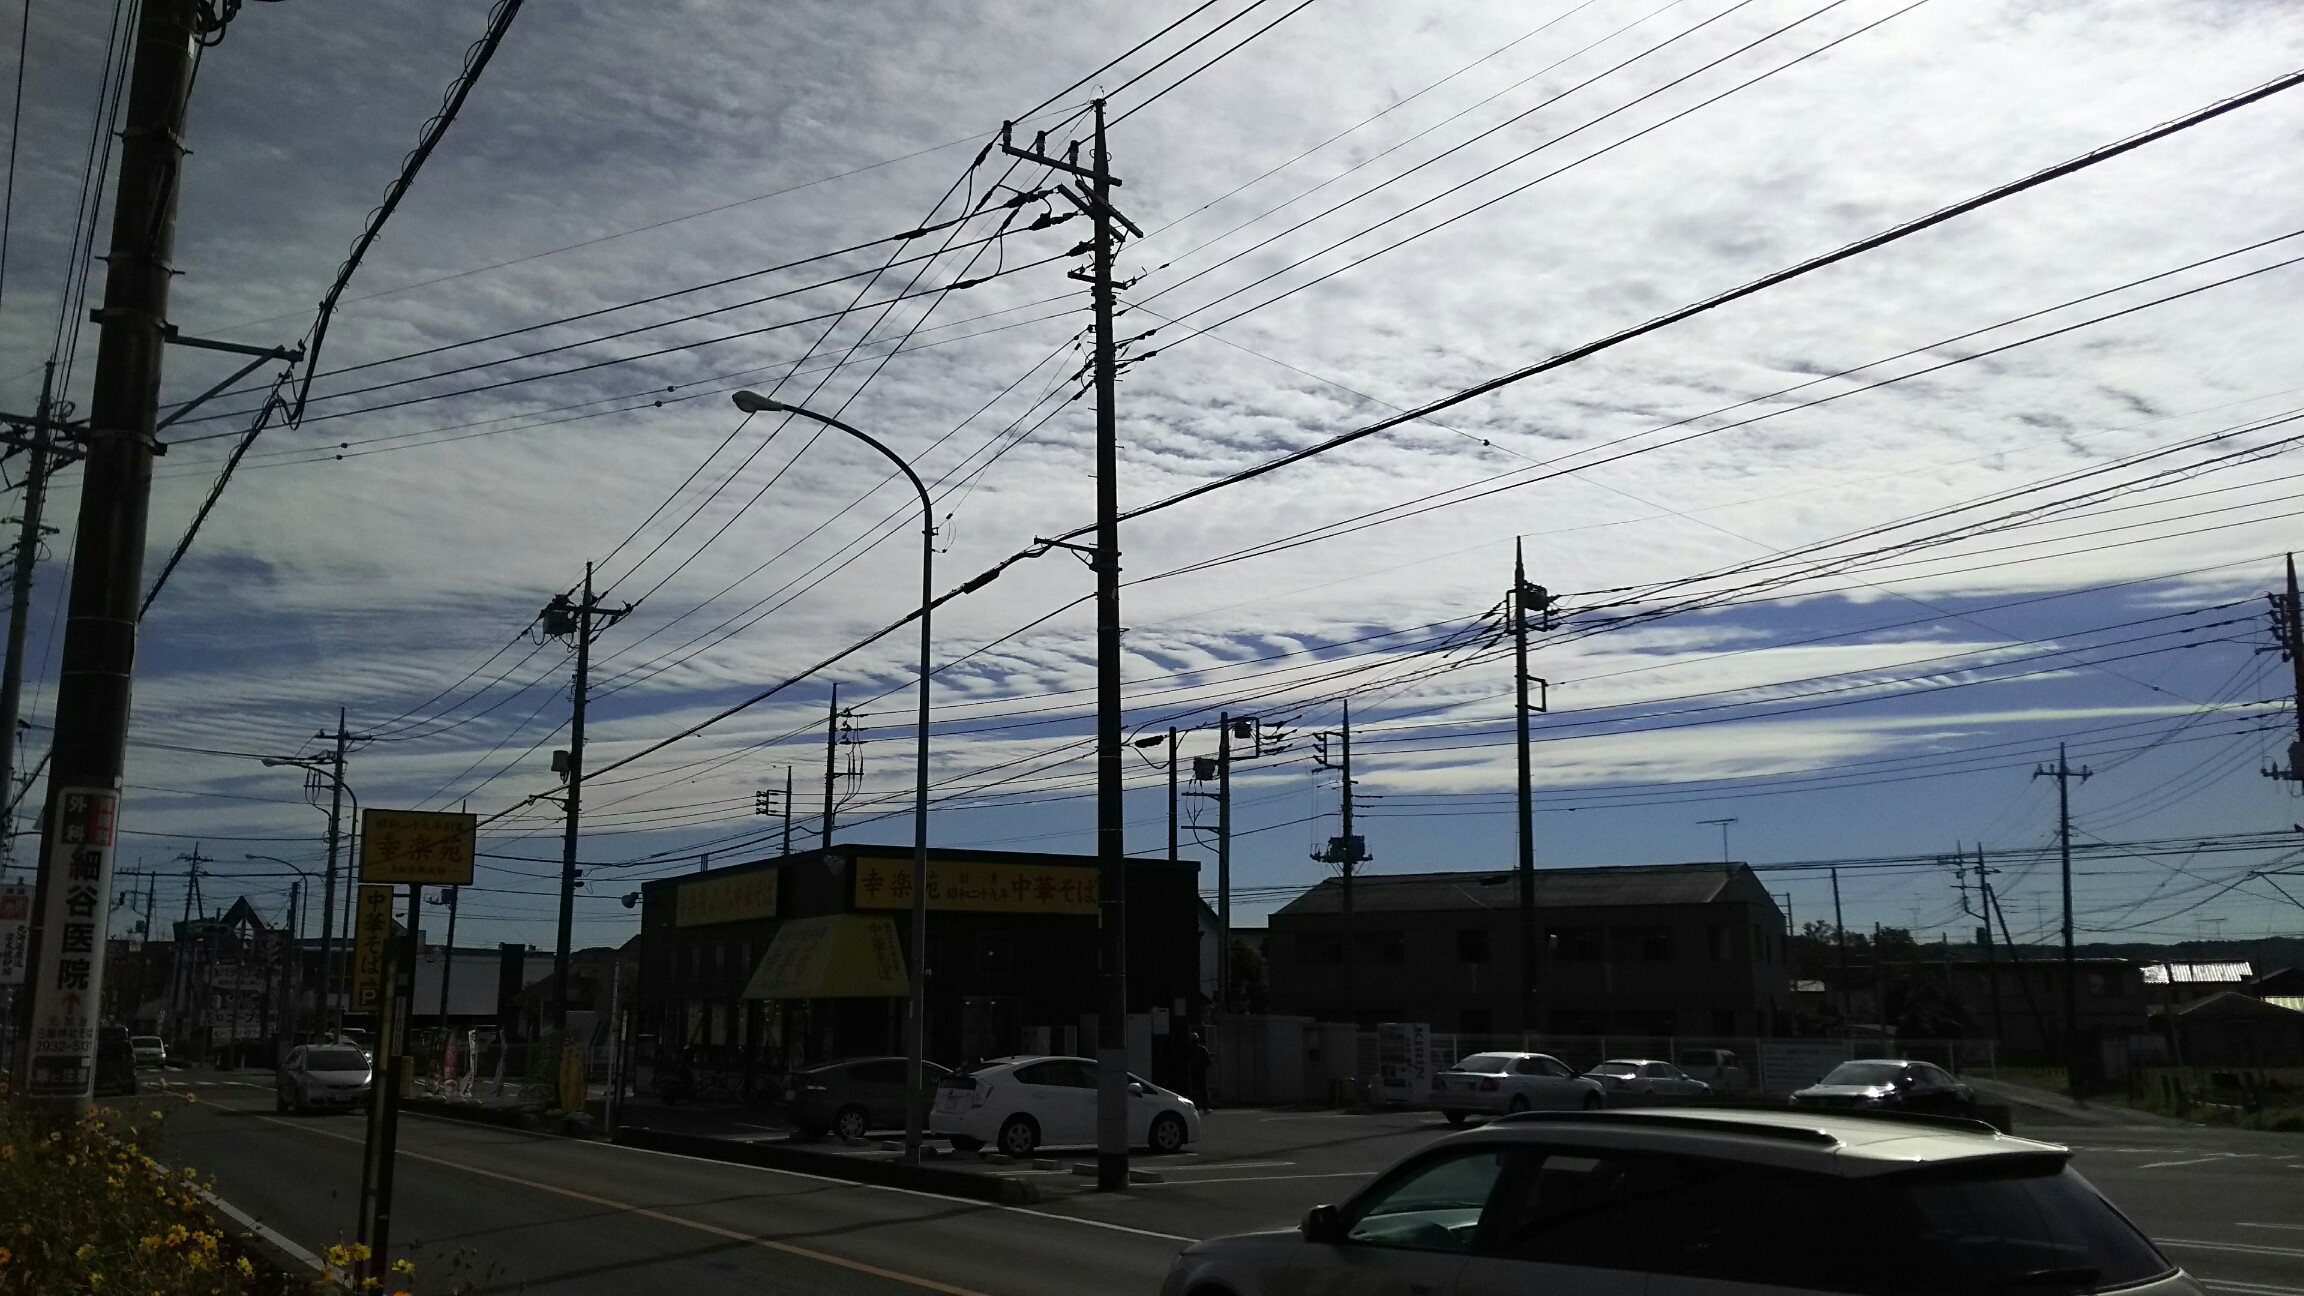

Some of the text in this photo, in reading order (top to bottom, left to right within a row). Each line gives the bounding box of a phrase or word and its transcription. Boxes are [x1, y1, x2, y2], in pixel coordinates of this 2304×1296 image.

[66, 795, 87, 842] 外科
[375, 832, 463, 863] 幸楽苑
[861, 867, 940, 899] 幸楽苑
[946, 887, 1009, 901] 昭和二十九年
[1011, 873, 1098, 904] 中華そば
[57, 849, 102, 991] 細谷医院
[360, 890, 386, 975] 中華そば
[867, 921, 894, 982] 中華そば
[361, 989, 377, 1005] P
[1414, 1027, 1426, 1080] KIRIN
